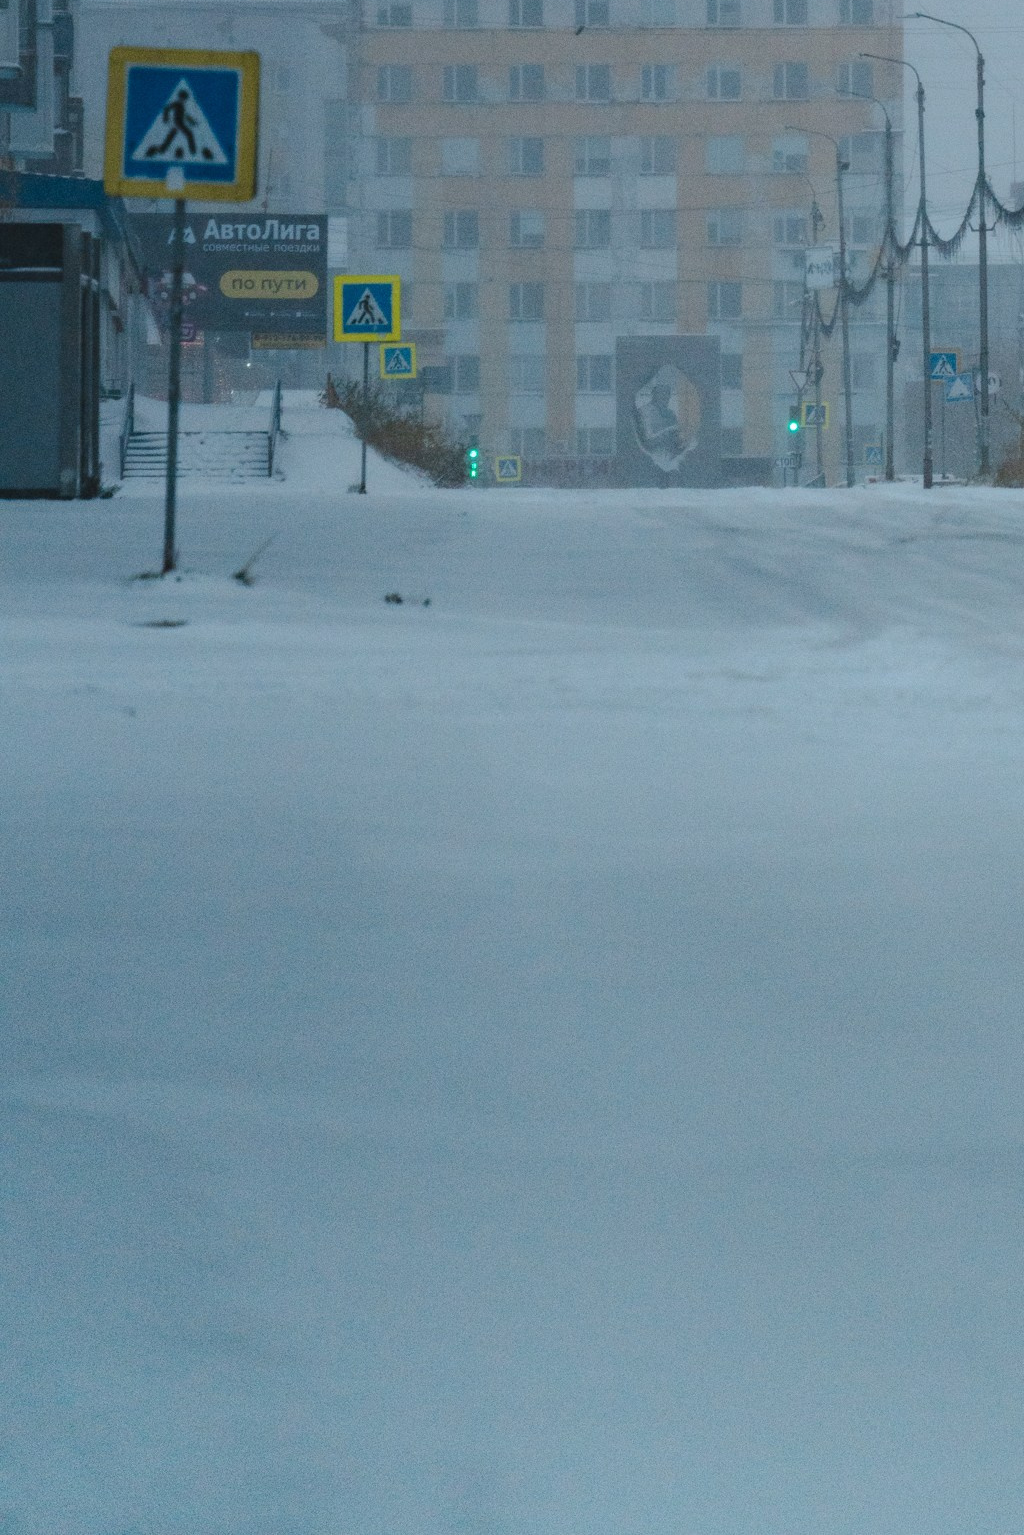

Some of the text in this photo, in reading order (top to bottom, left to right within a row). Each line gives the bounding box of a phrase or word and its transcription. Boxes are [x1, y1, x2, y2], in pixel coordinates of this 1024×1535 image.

[203, 218, 320, 241] АвтоЛига
[202, 243, 320, 254] совместные поездки
[231, 278, 307, 293] по пути
